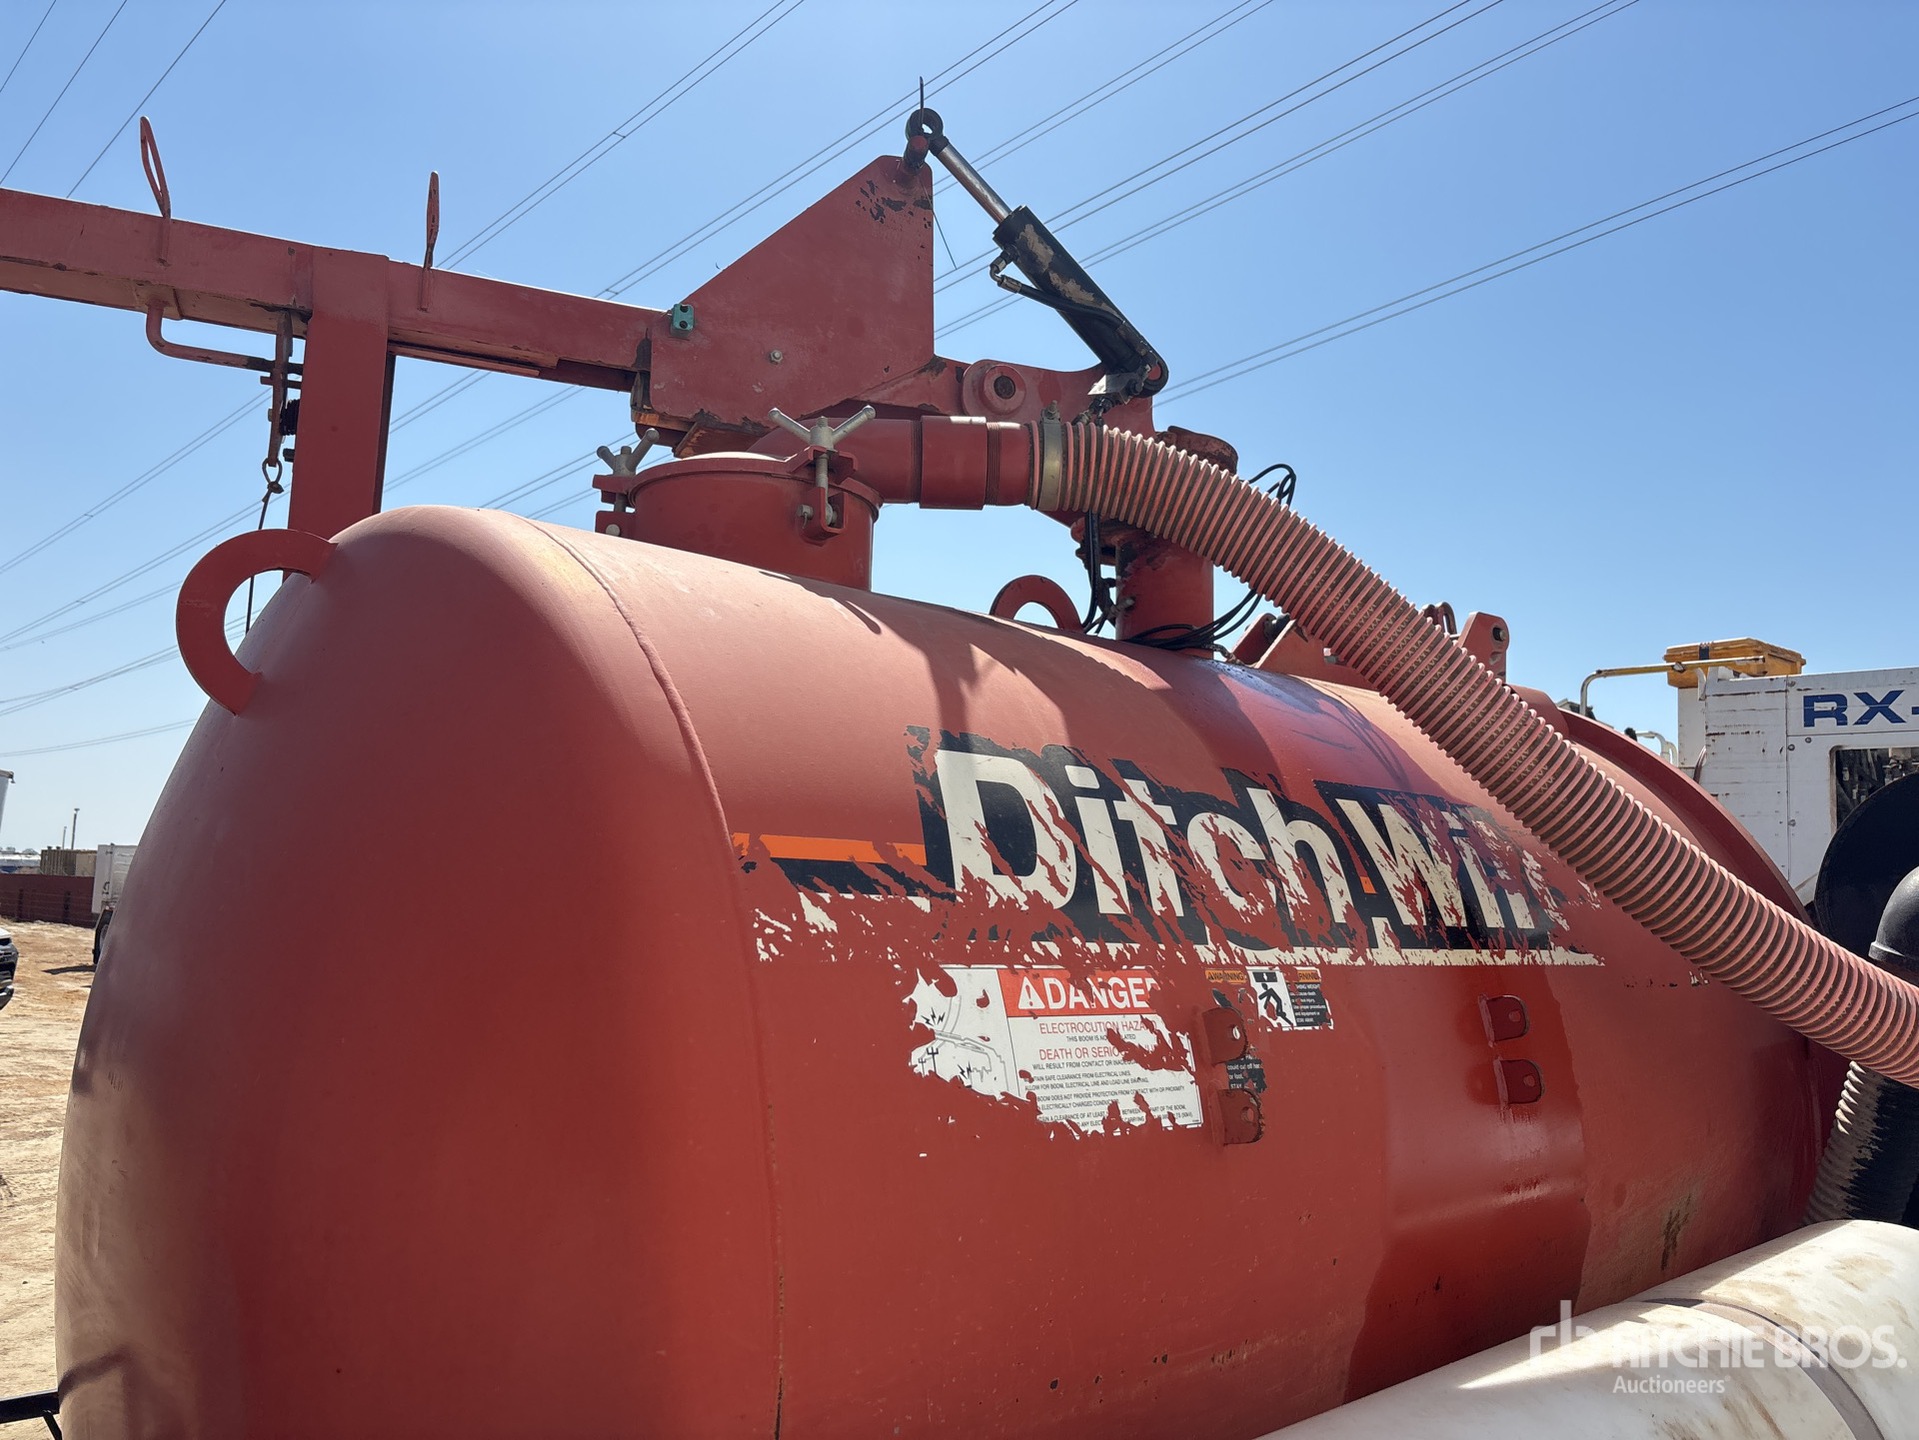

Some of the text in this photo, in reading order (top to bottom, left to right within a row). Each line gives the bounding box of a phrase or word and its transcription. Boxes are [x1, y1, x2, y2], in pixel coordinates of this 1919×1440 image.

[934, 748, 1354, 928] Ditch
[1039, 1048, 1073, 1061] DEATH
[1074, 1046, 1090, 1059] OR
[1045, 1062, 1065, 1070] RESULT
[1066, 1061, 1081, 1069] FROM
[1081, 1060, 1105, 1068] CONTACT
